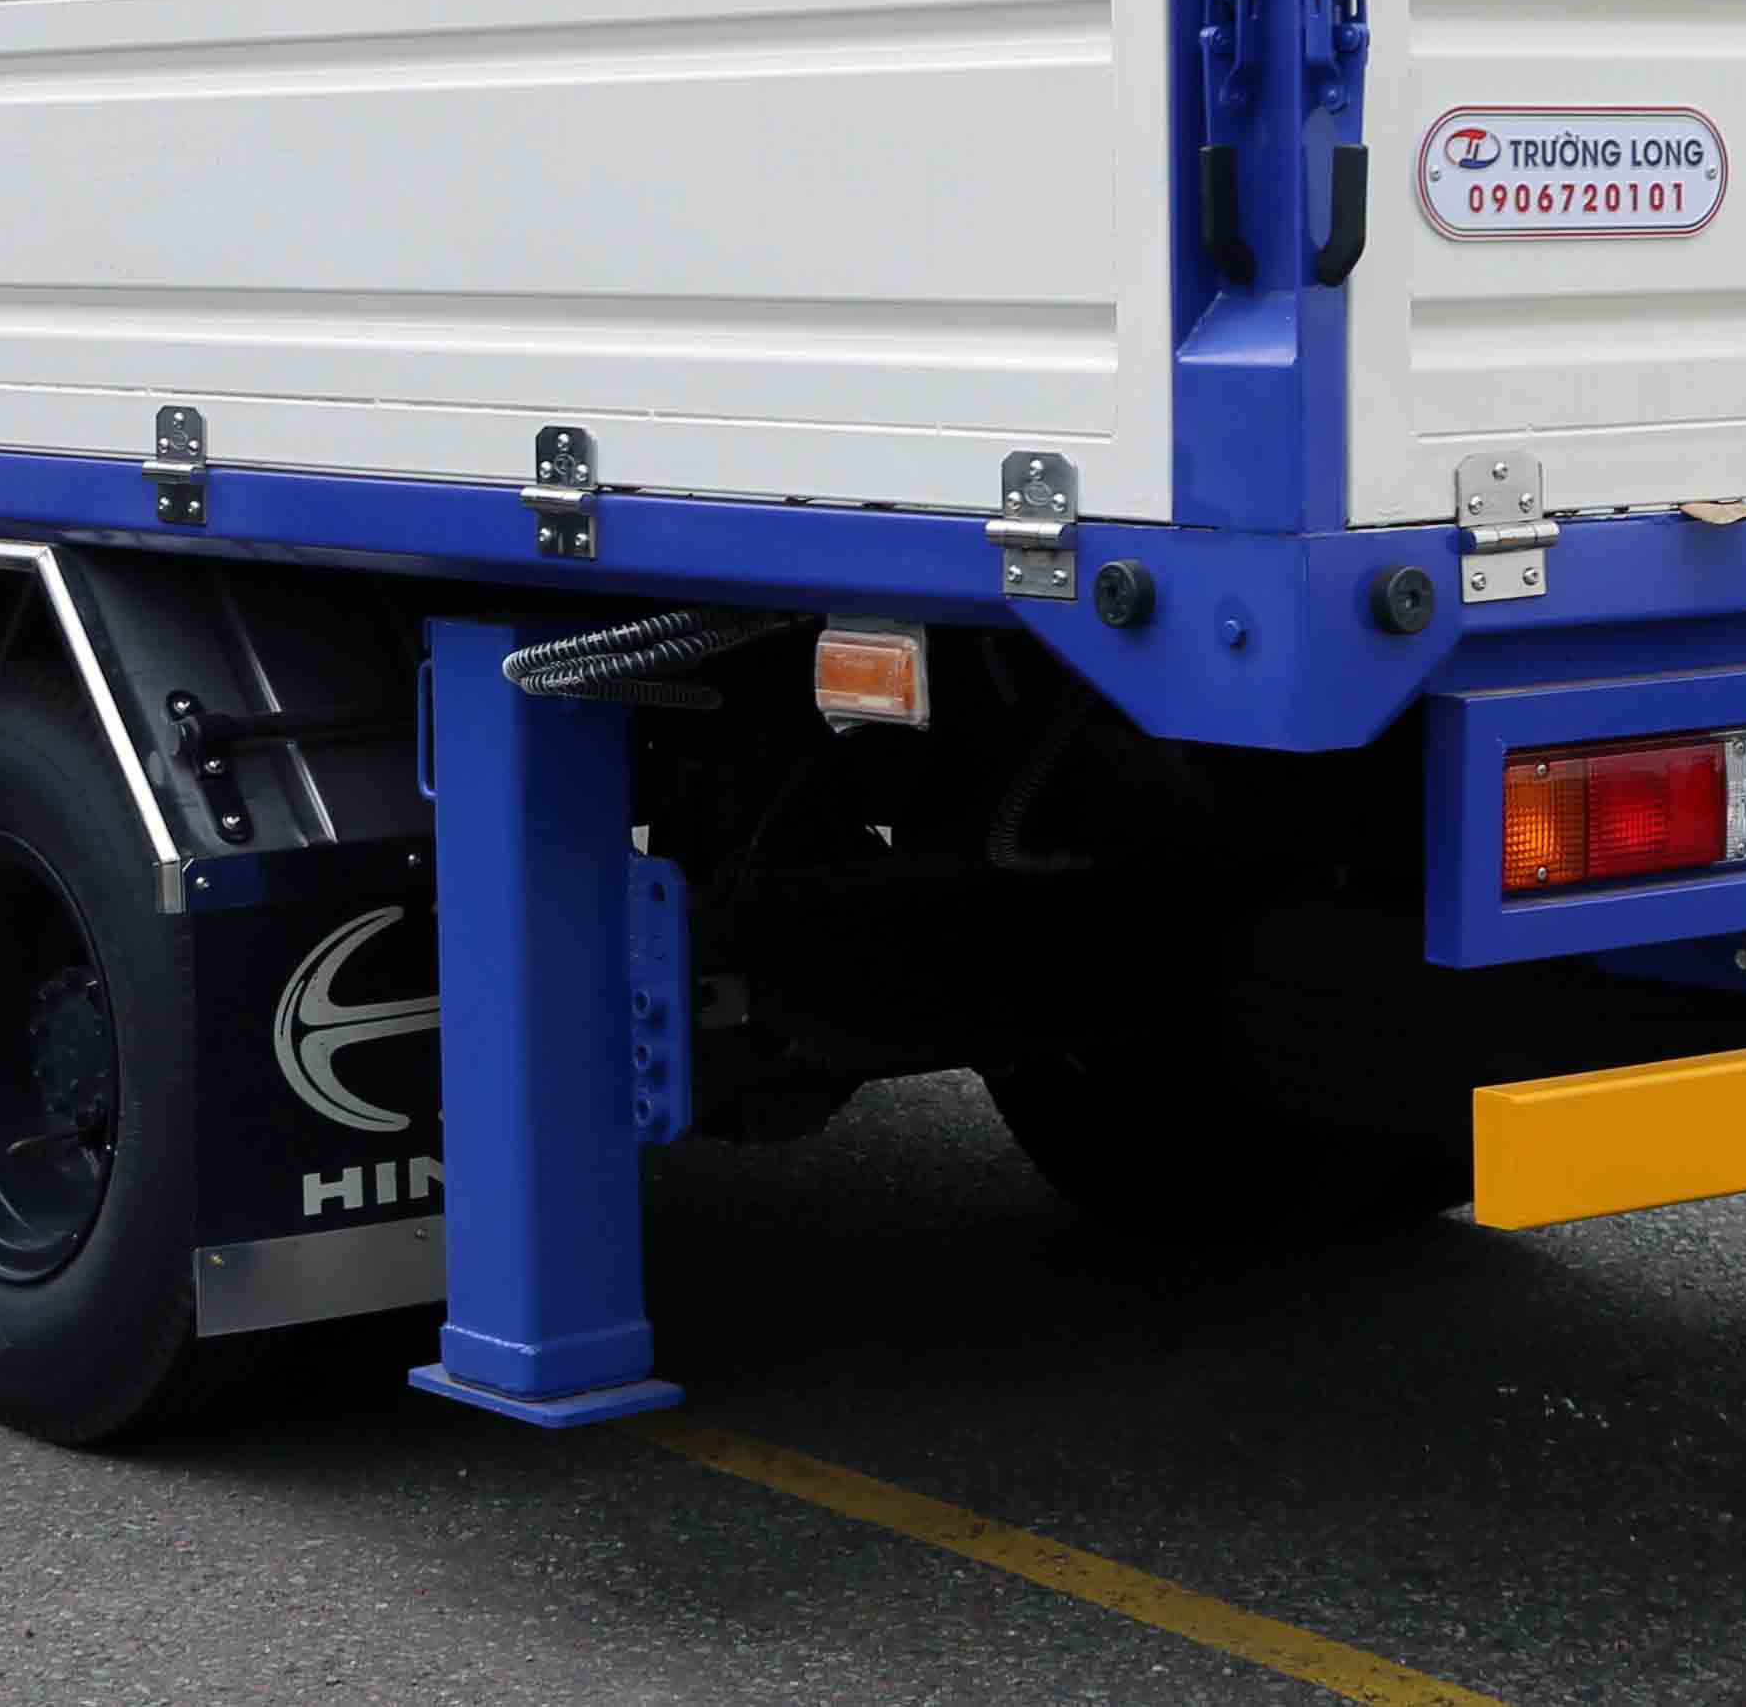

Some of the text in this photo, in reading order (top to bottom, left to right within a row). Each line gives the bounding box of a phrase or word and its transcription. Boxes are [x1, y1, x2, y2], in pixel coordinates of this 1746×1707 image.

[1509, 130, 1704, 168] TRƯỜNG LONG
[1468, 181, 1685, 215] 0906720101
